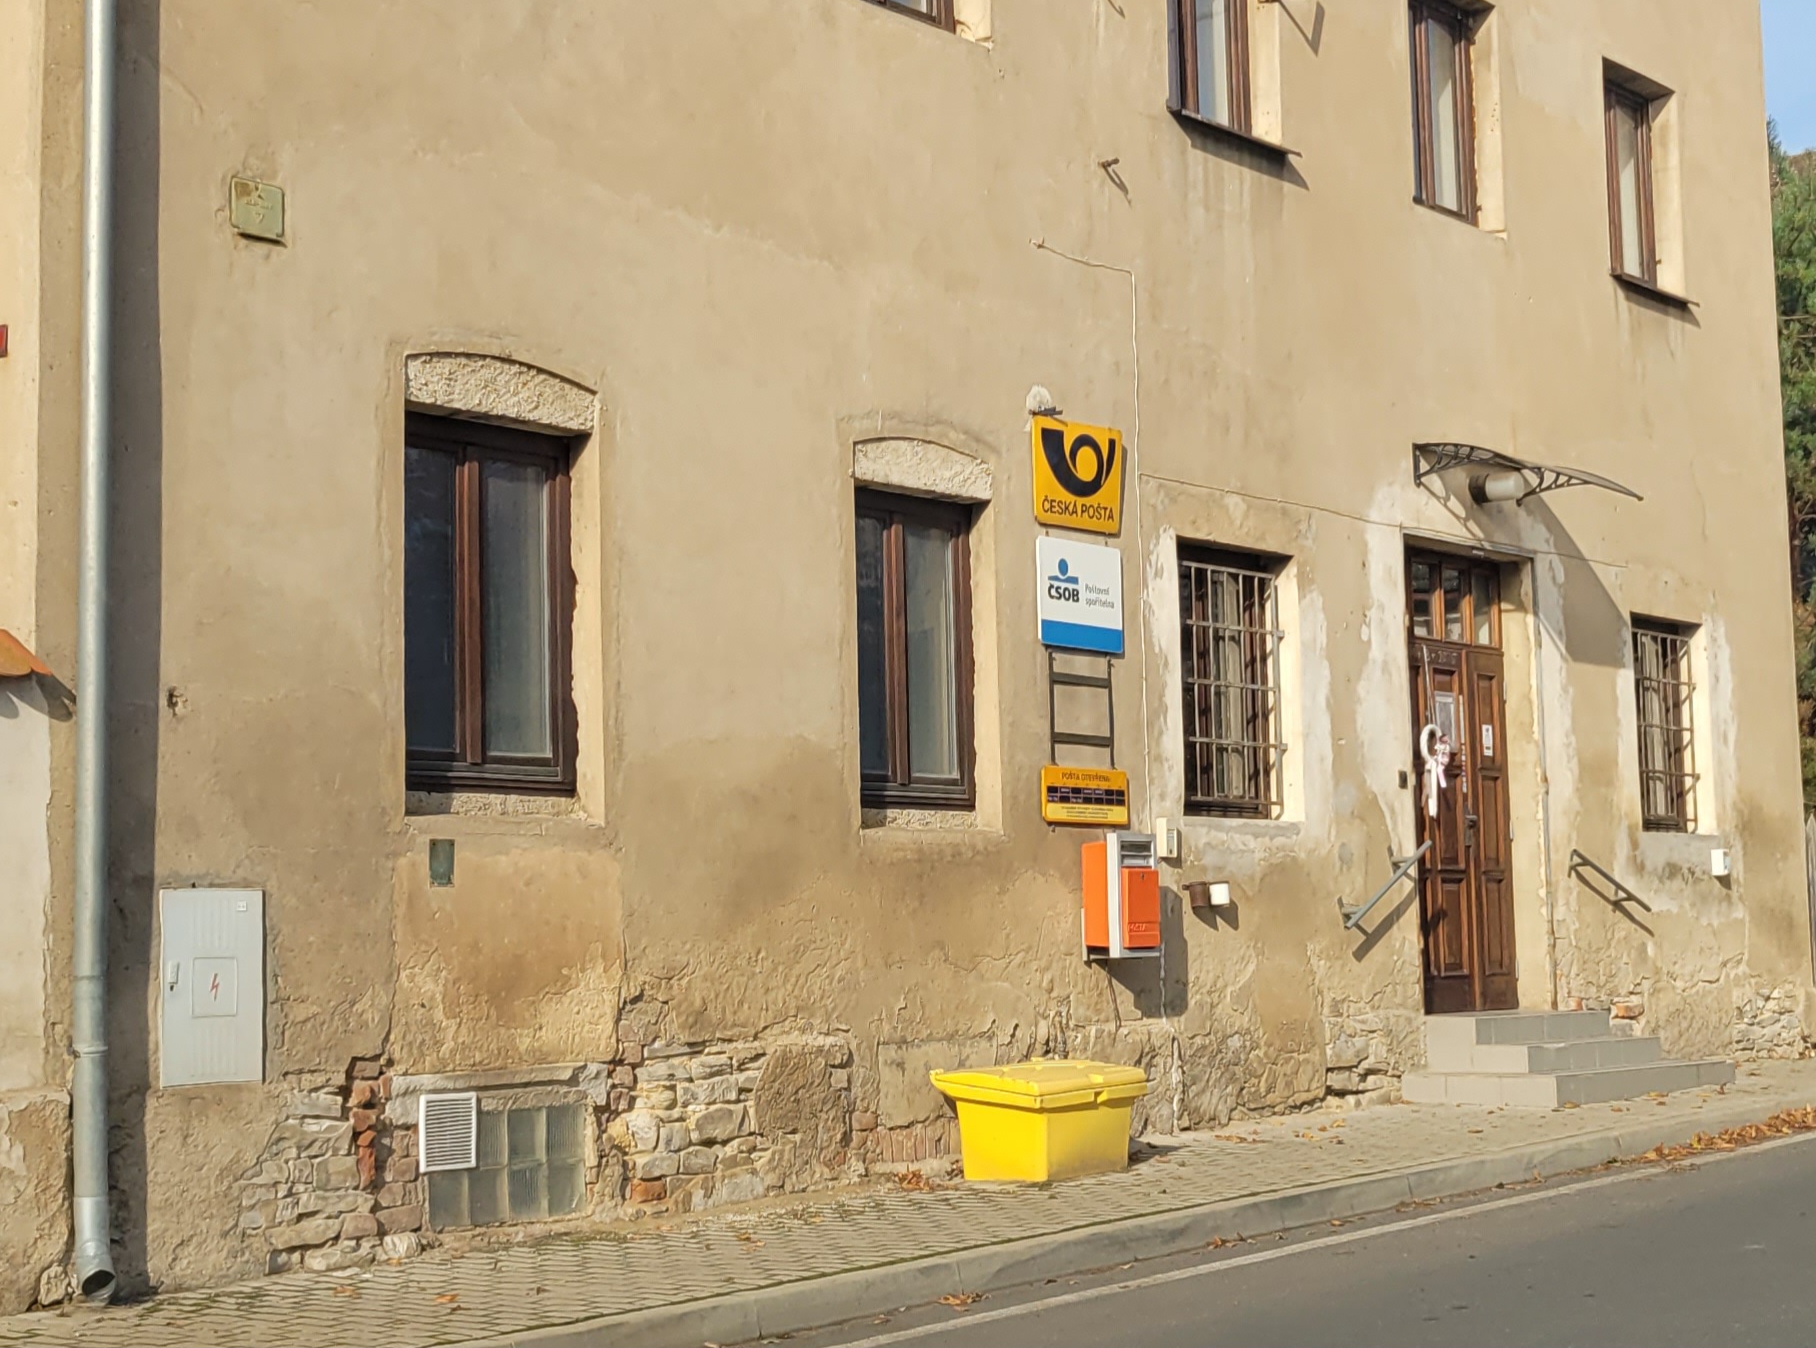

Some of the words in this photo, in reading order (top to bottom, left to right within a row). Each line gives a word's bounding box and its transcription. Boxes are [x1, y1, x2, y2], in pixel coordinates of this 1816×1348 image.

[1042, 495, 1078, 518] ČESKÁ
[1080, 502, 1115, 522] POŠTA
[1047, 582, 1080, 603] ČSOB
